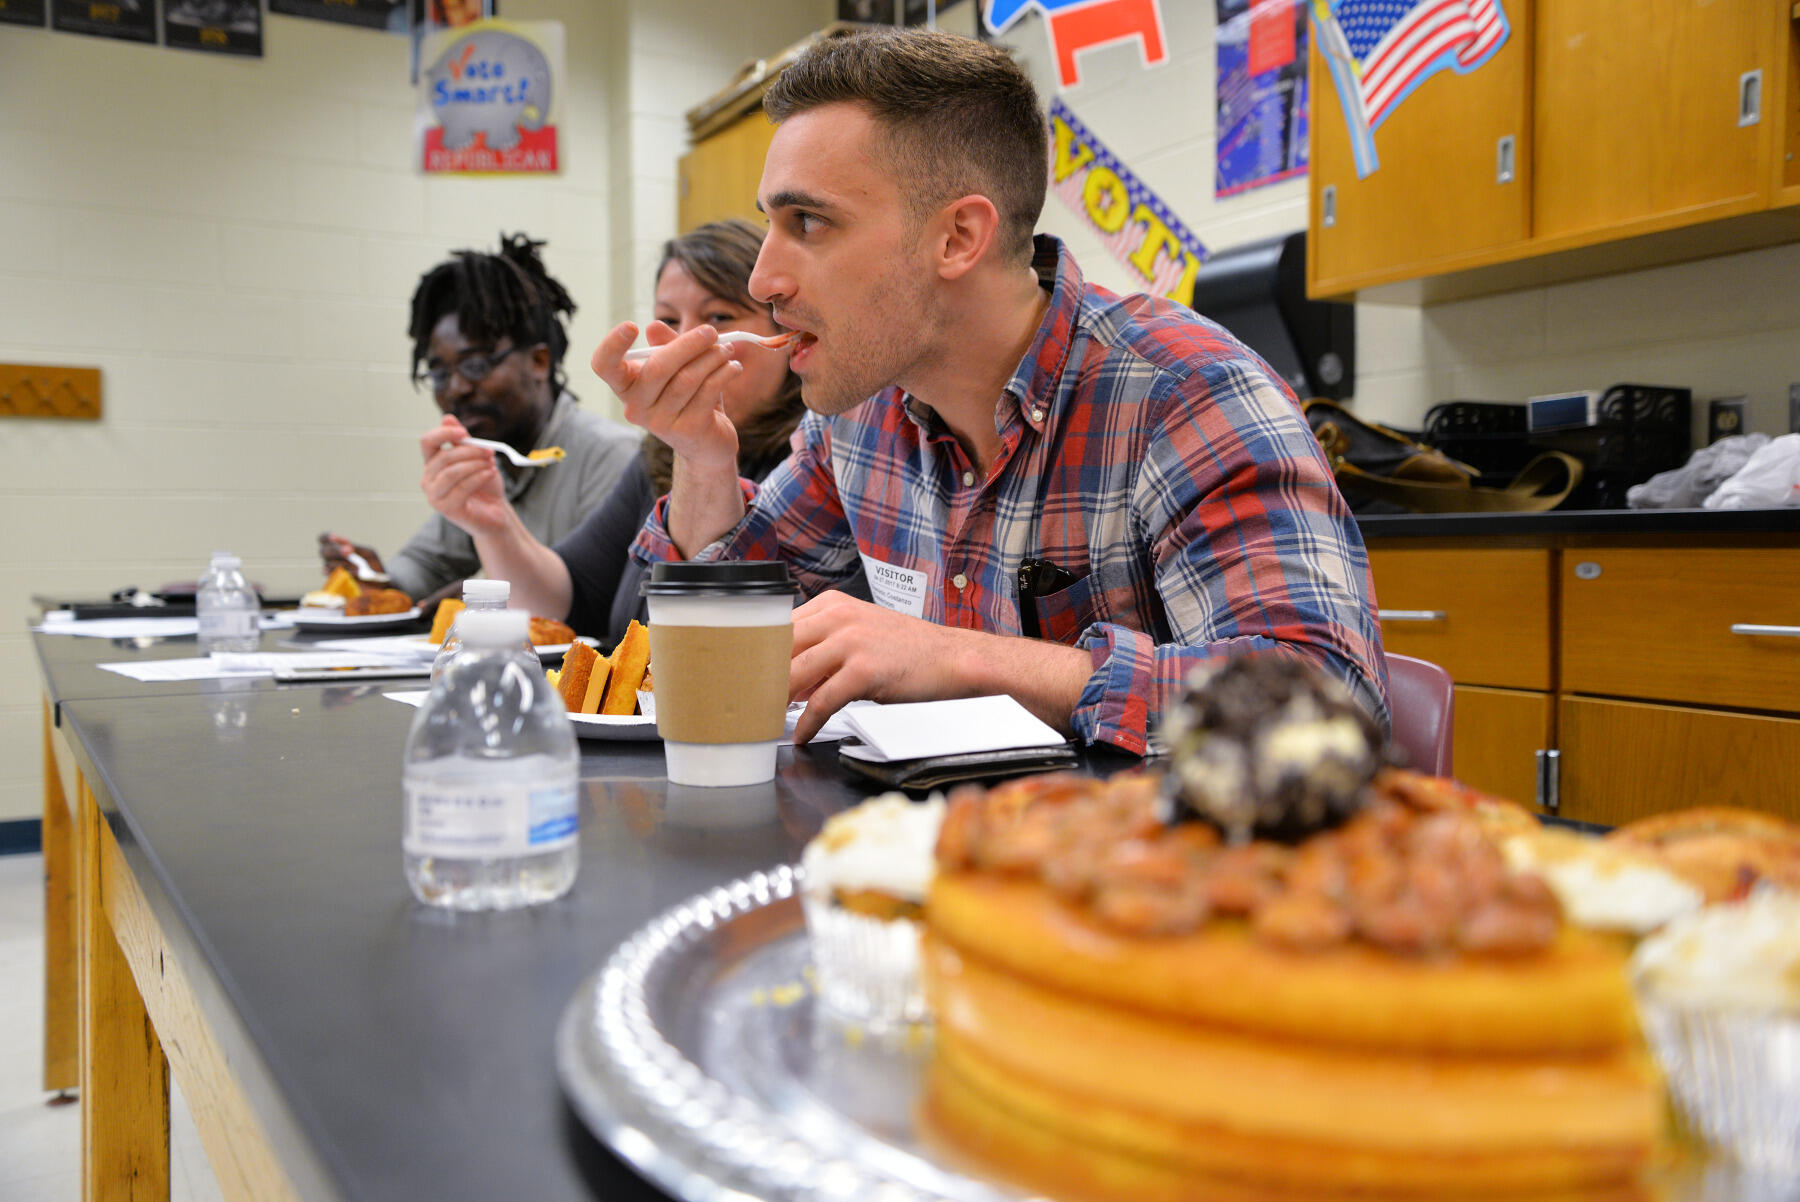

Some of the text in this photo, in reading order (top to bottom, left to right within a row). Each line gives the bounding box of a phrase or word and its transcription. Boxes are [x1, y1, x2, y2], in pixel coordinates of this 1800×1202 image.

[433, 78, 529, 106] Smart!
[429, 149, 551, 171] REPUBLICAN
[875, 566, 914, 584] VISITOR
